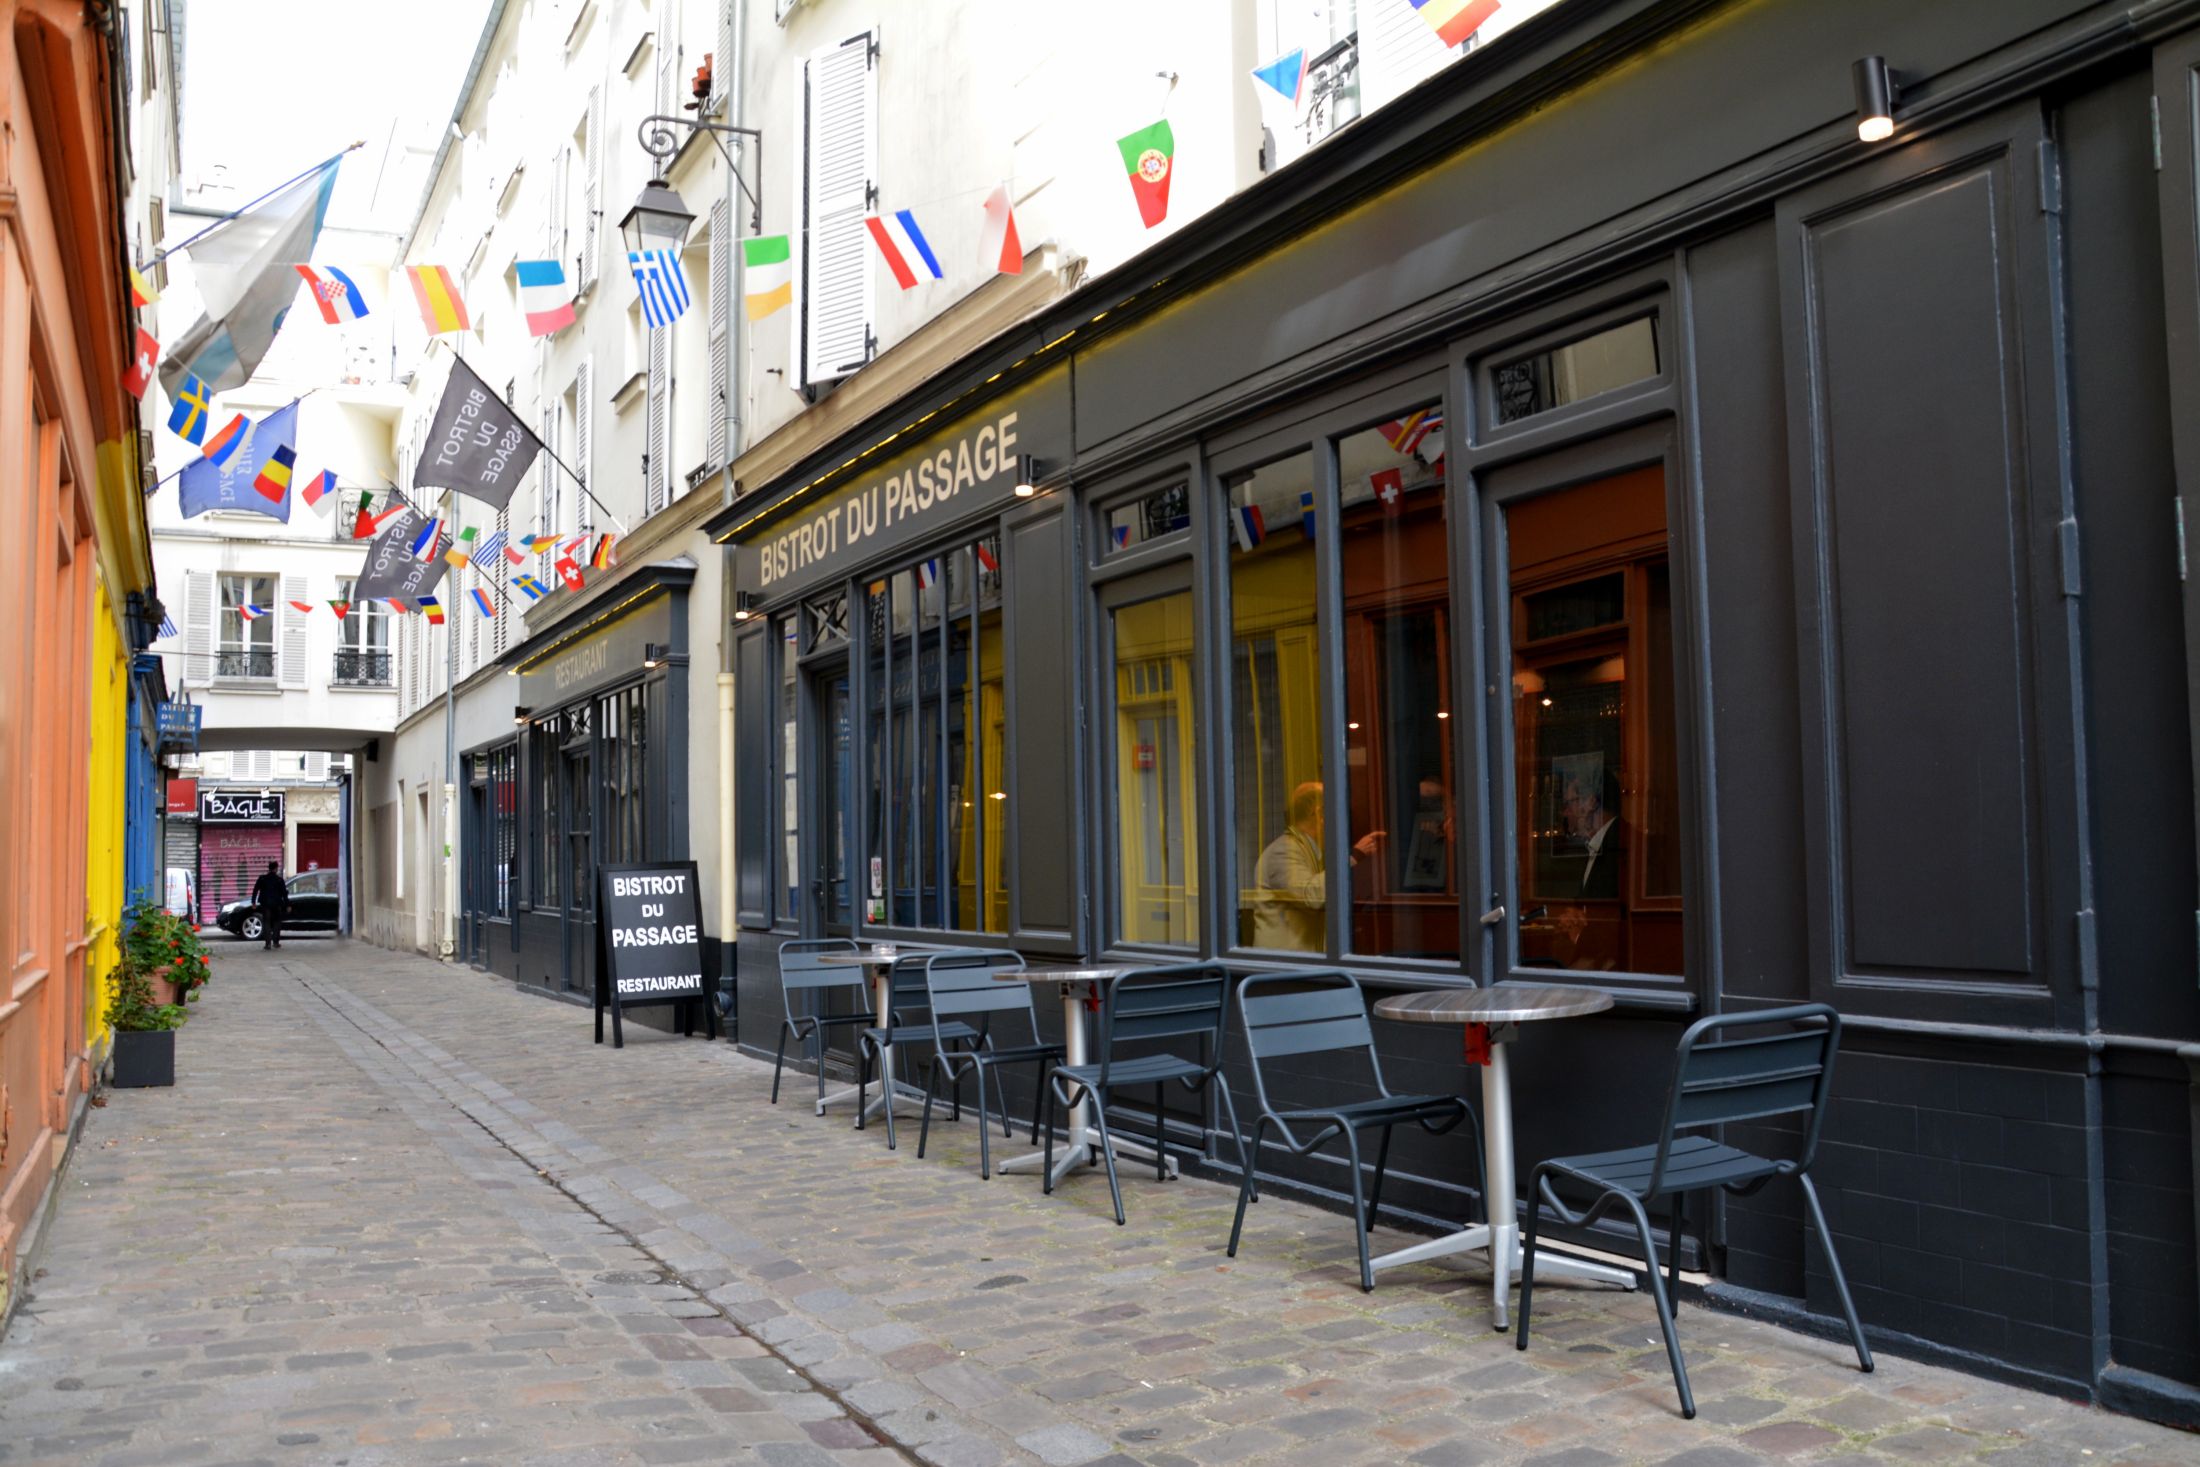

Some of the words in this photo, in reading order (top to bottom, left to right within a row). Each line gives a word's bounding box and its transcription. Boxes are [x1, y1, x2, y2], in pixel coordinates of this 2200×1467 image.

[760, 506, 841, 587] BISTROT
[846, 486, 878, 546] DU
[885, 411, 1018, 528] PASSAGE
[555, 640, 609, 690] RESTAURANT
[211, 799, 273, 818] BAGUE
[613, 875, 685, 897] BISTROT
[641, 903, 664, 918] DU
[612, 925, 698, 948] PASSAGE
[617, 974, 702, 993] RESTAURANT
